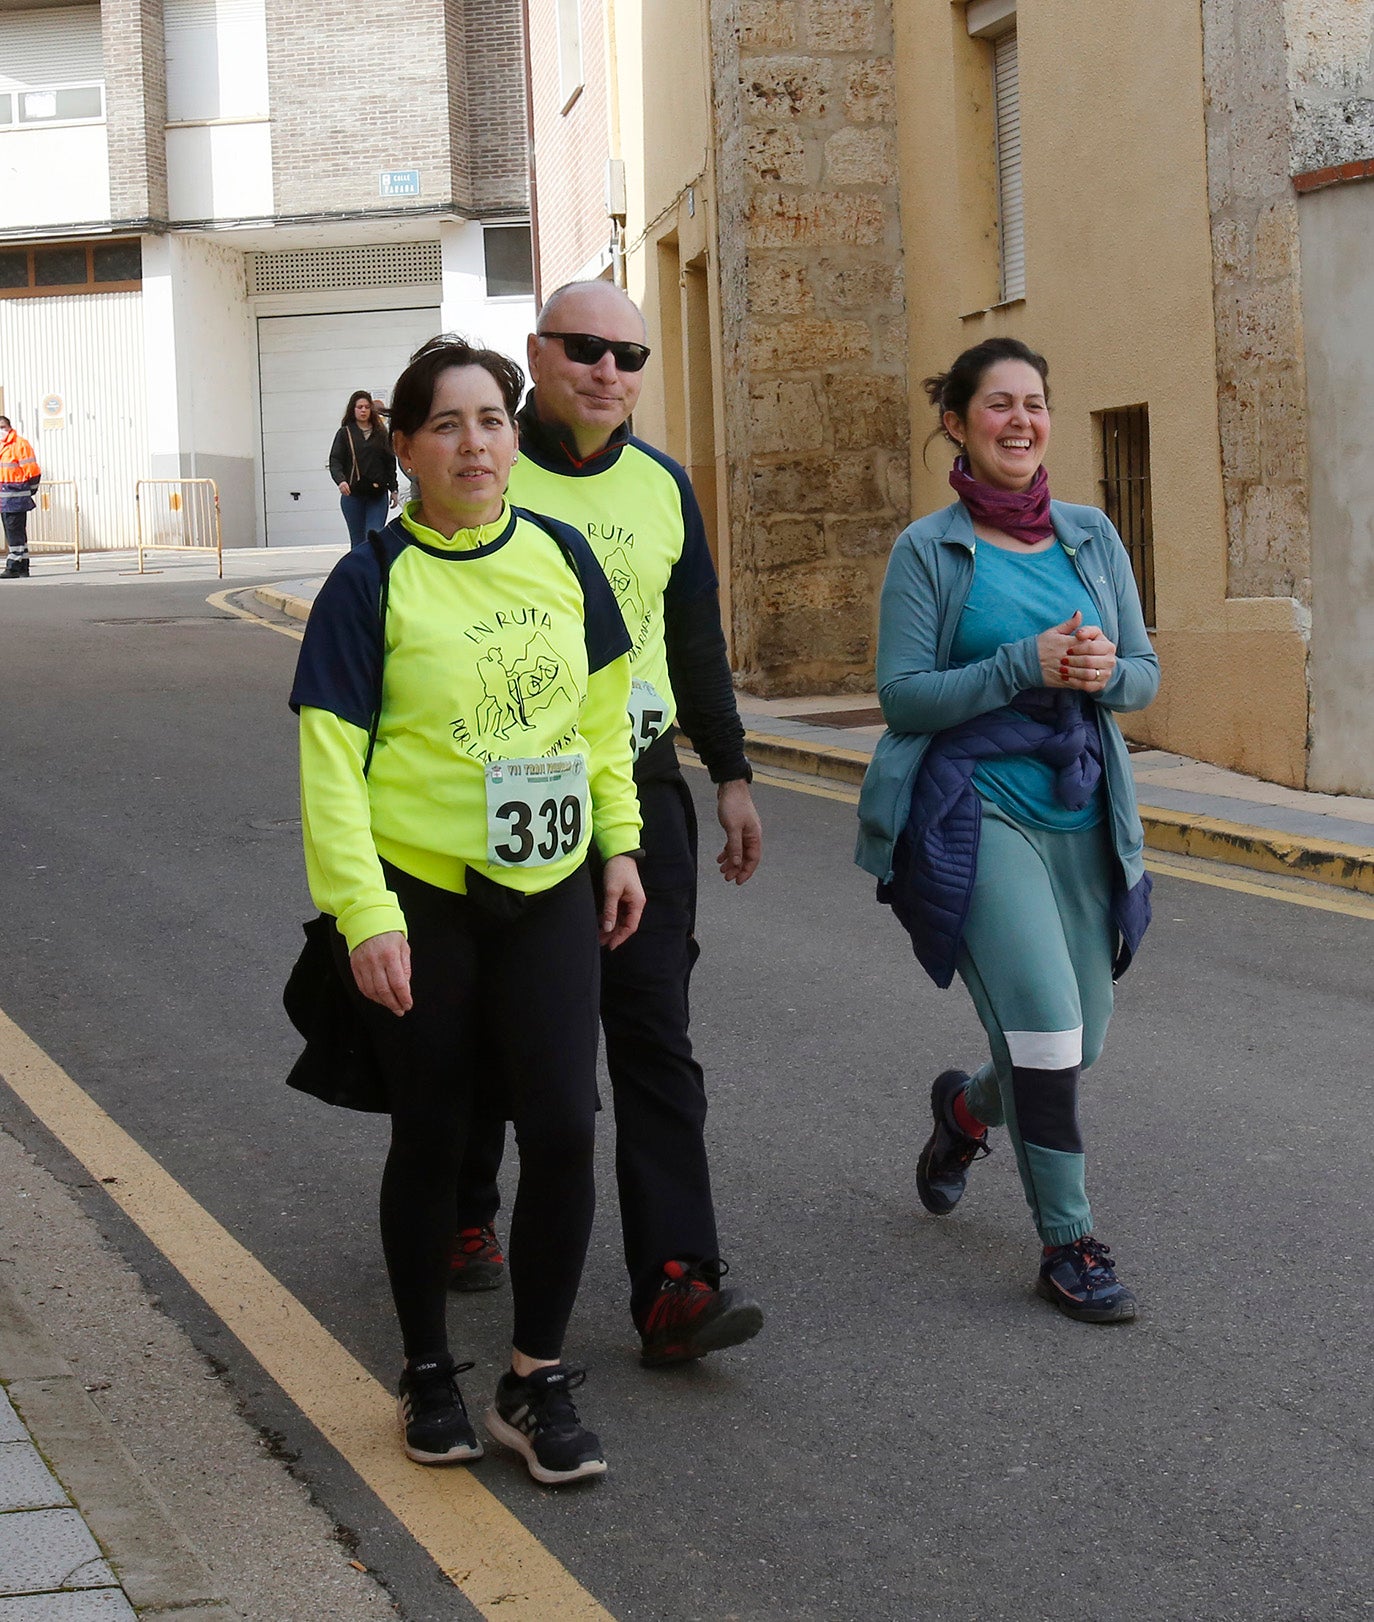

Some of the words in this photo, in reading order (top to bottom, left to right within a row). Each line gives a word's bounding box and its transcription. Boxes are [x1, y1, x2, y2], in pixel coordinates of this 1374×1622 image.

[587, 522, 635, 549] RUTA
[463, 620, 495, 645] EN
[495, 607, 552, 630] RUTA
[449, 718, 471, 748] POR
[628, 709, 663, 754] 5
[494, 794, 581, 863] 339
